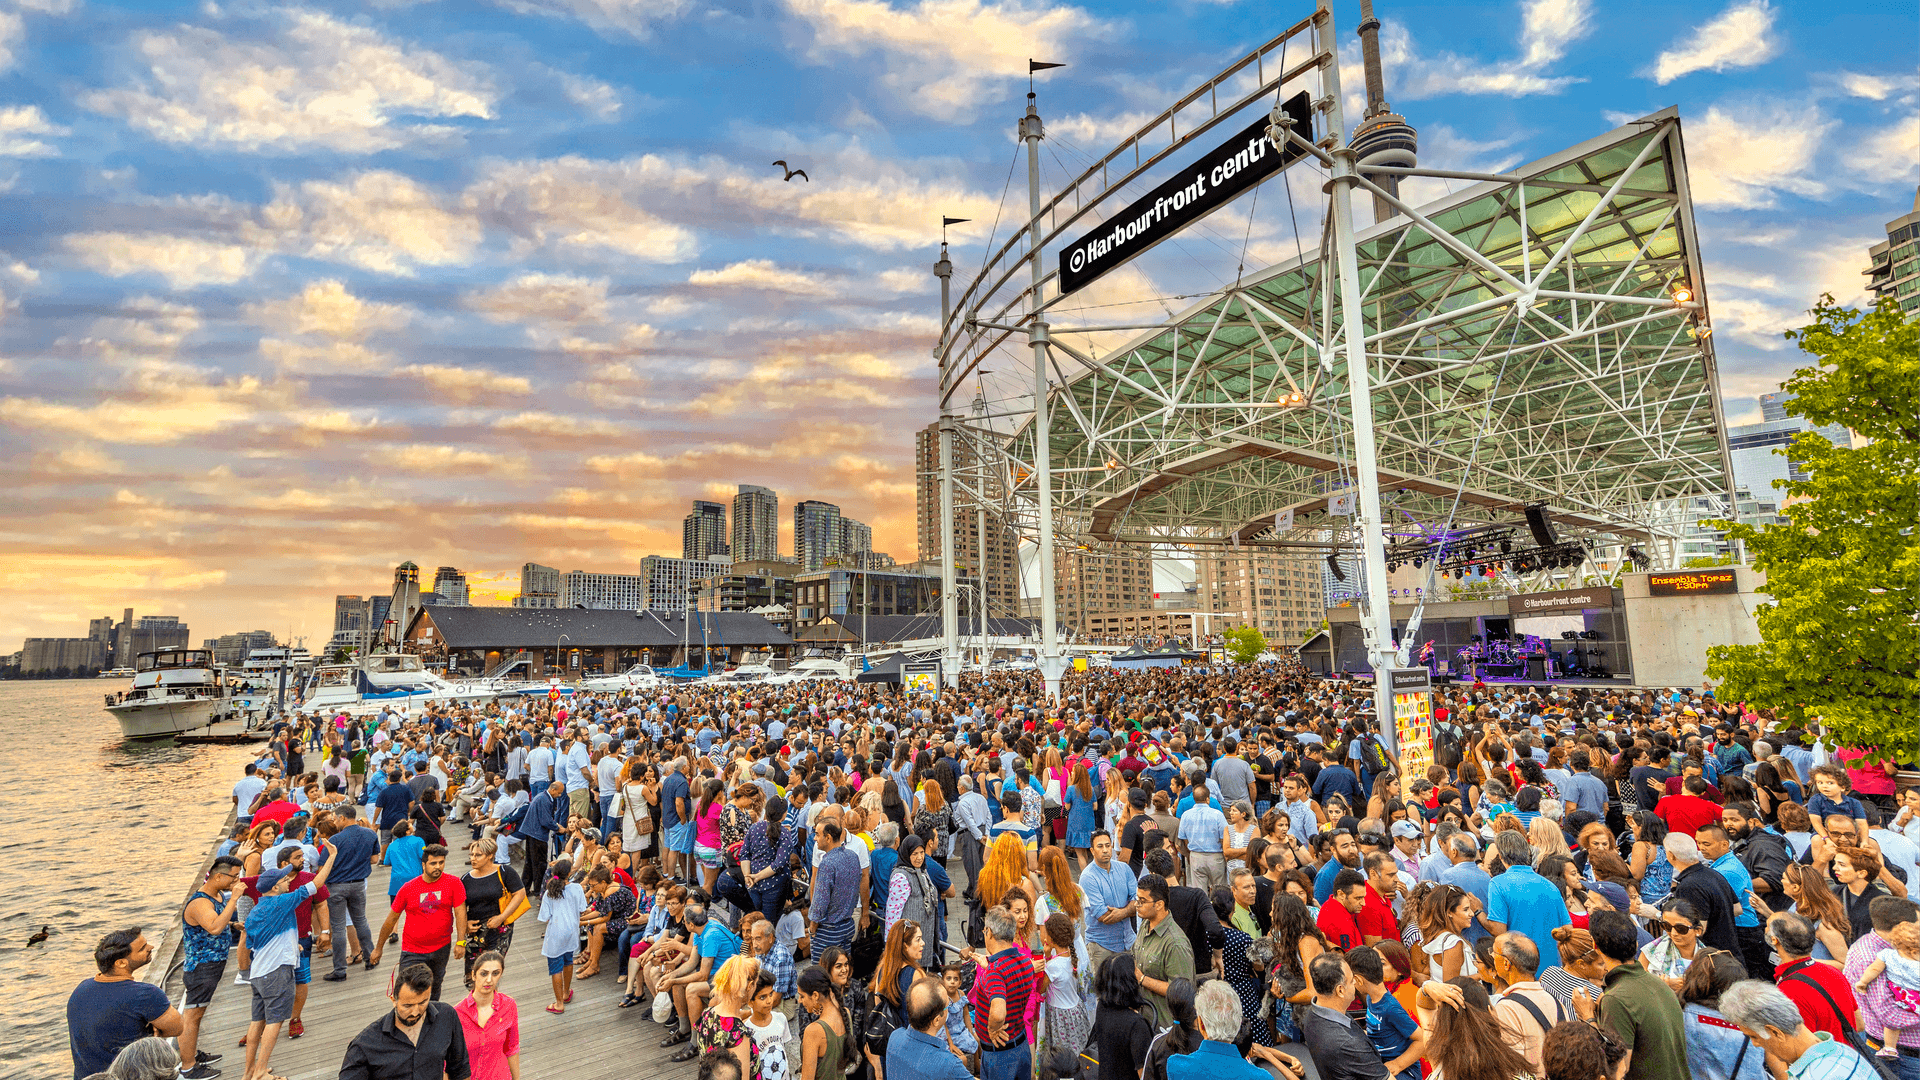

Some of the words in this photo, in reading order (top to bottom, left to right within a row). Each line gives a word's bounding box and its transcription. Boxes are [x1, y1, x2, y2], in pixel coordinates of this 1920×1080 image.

[1087, 172, 1206, 264] Harbourfront
[1651, 576, 1697, 585] Ensemble
[1676, 582, 1709, 590] 1:30pm
[1531, 597, 1569, 607] Harbourfront
[1570, 595, 1591, 604] centre
